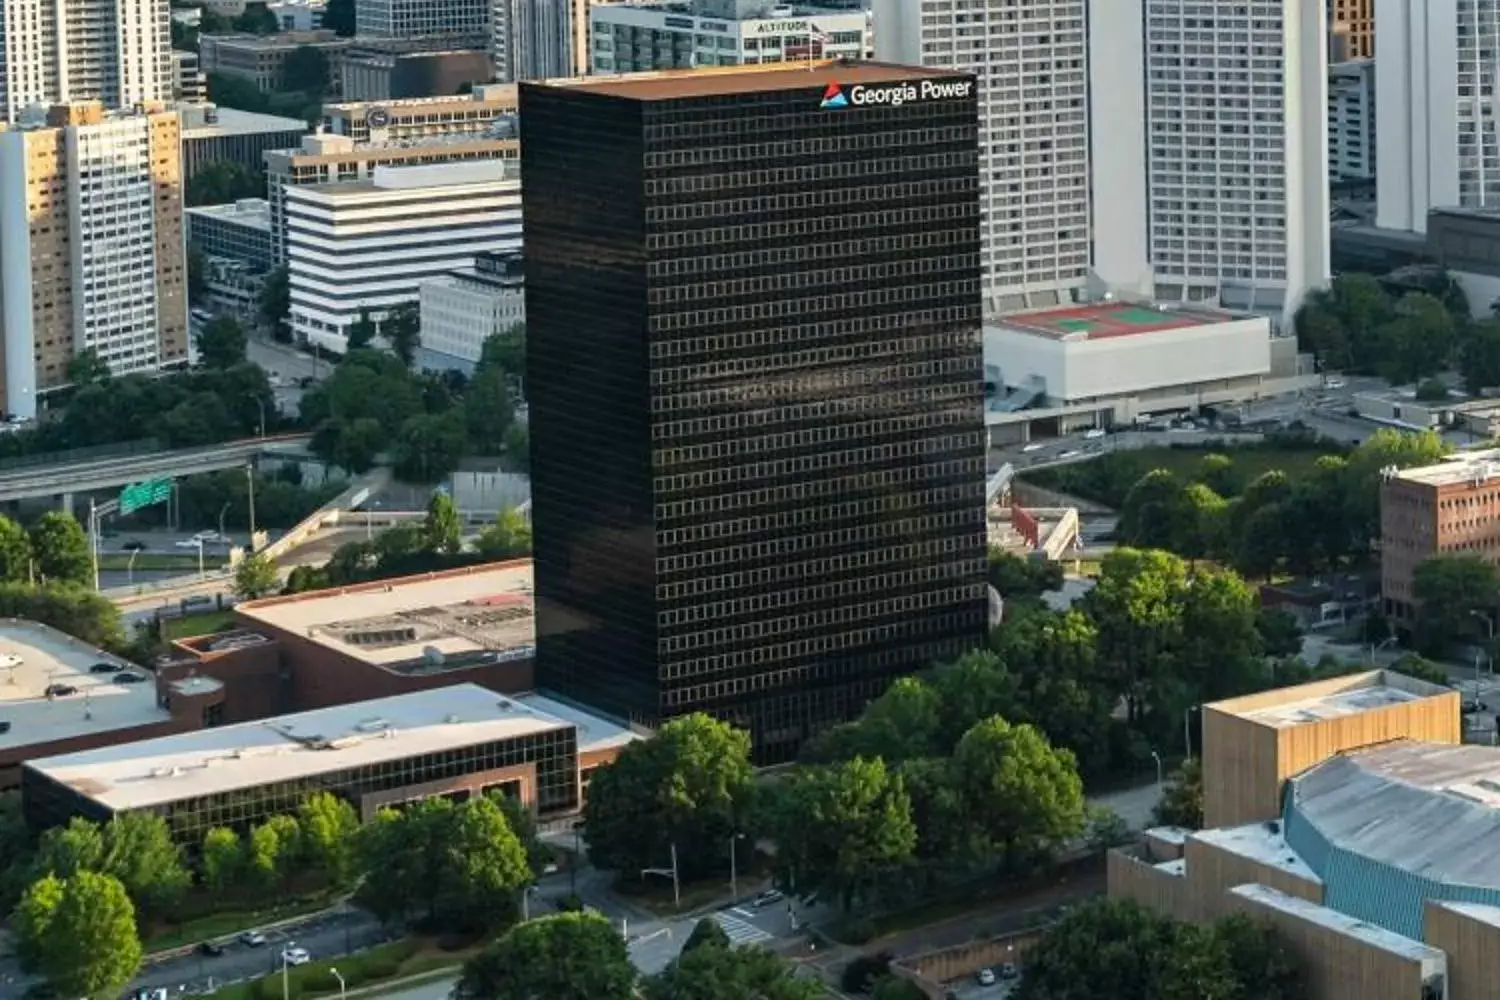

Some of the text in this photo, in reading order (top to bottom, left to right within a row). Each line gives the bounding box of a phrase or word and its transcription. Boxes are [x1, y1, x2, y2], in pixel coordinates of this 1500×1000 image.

[758, 21, 808, 32] ALTITUDE
[851, 80, 972, 105] Georgia Power
